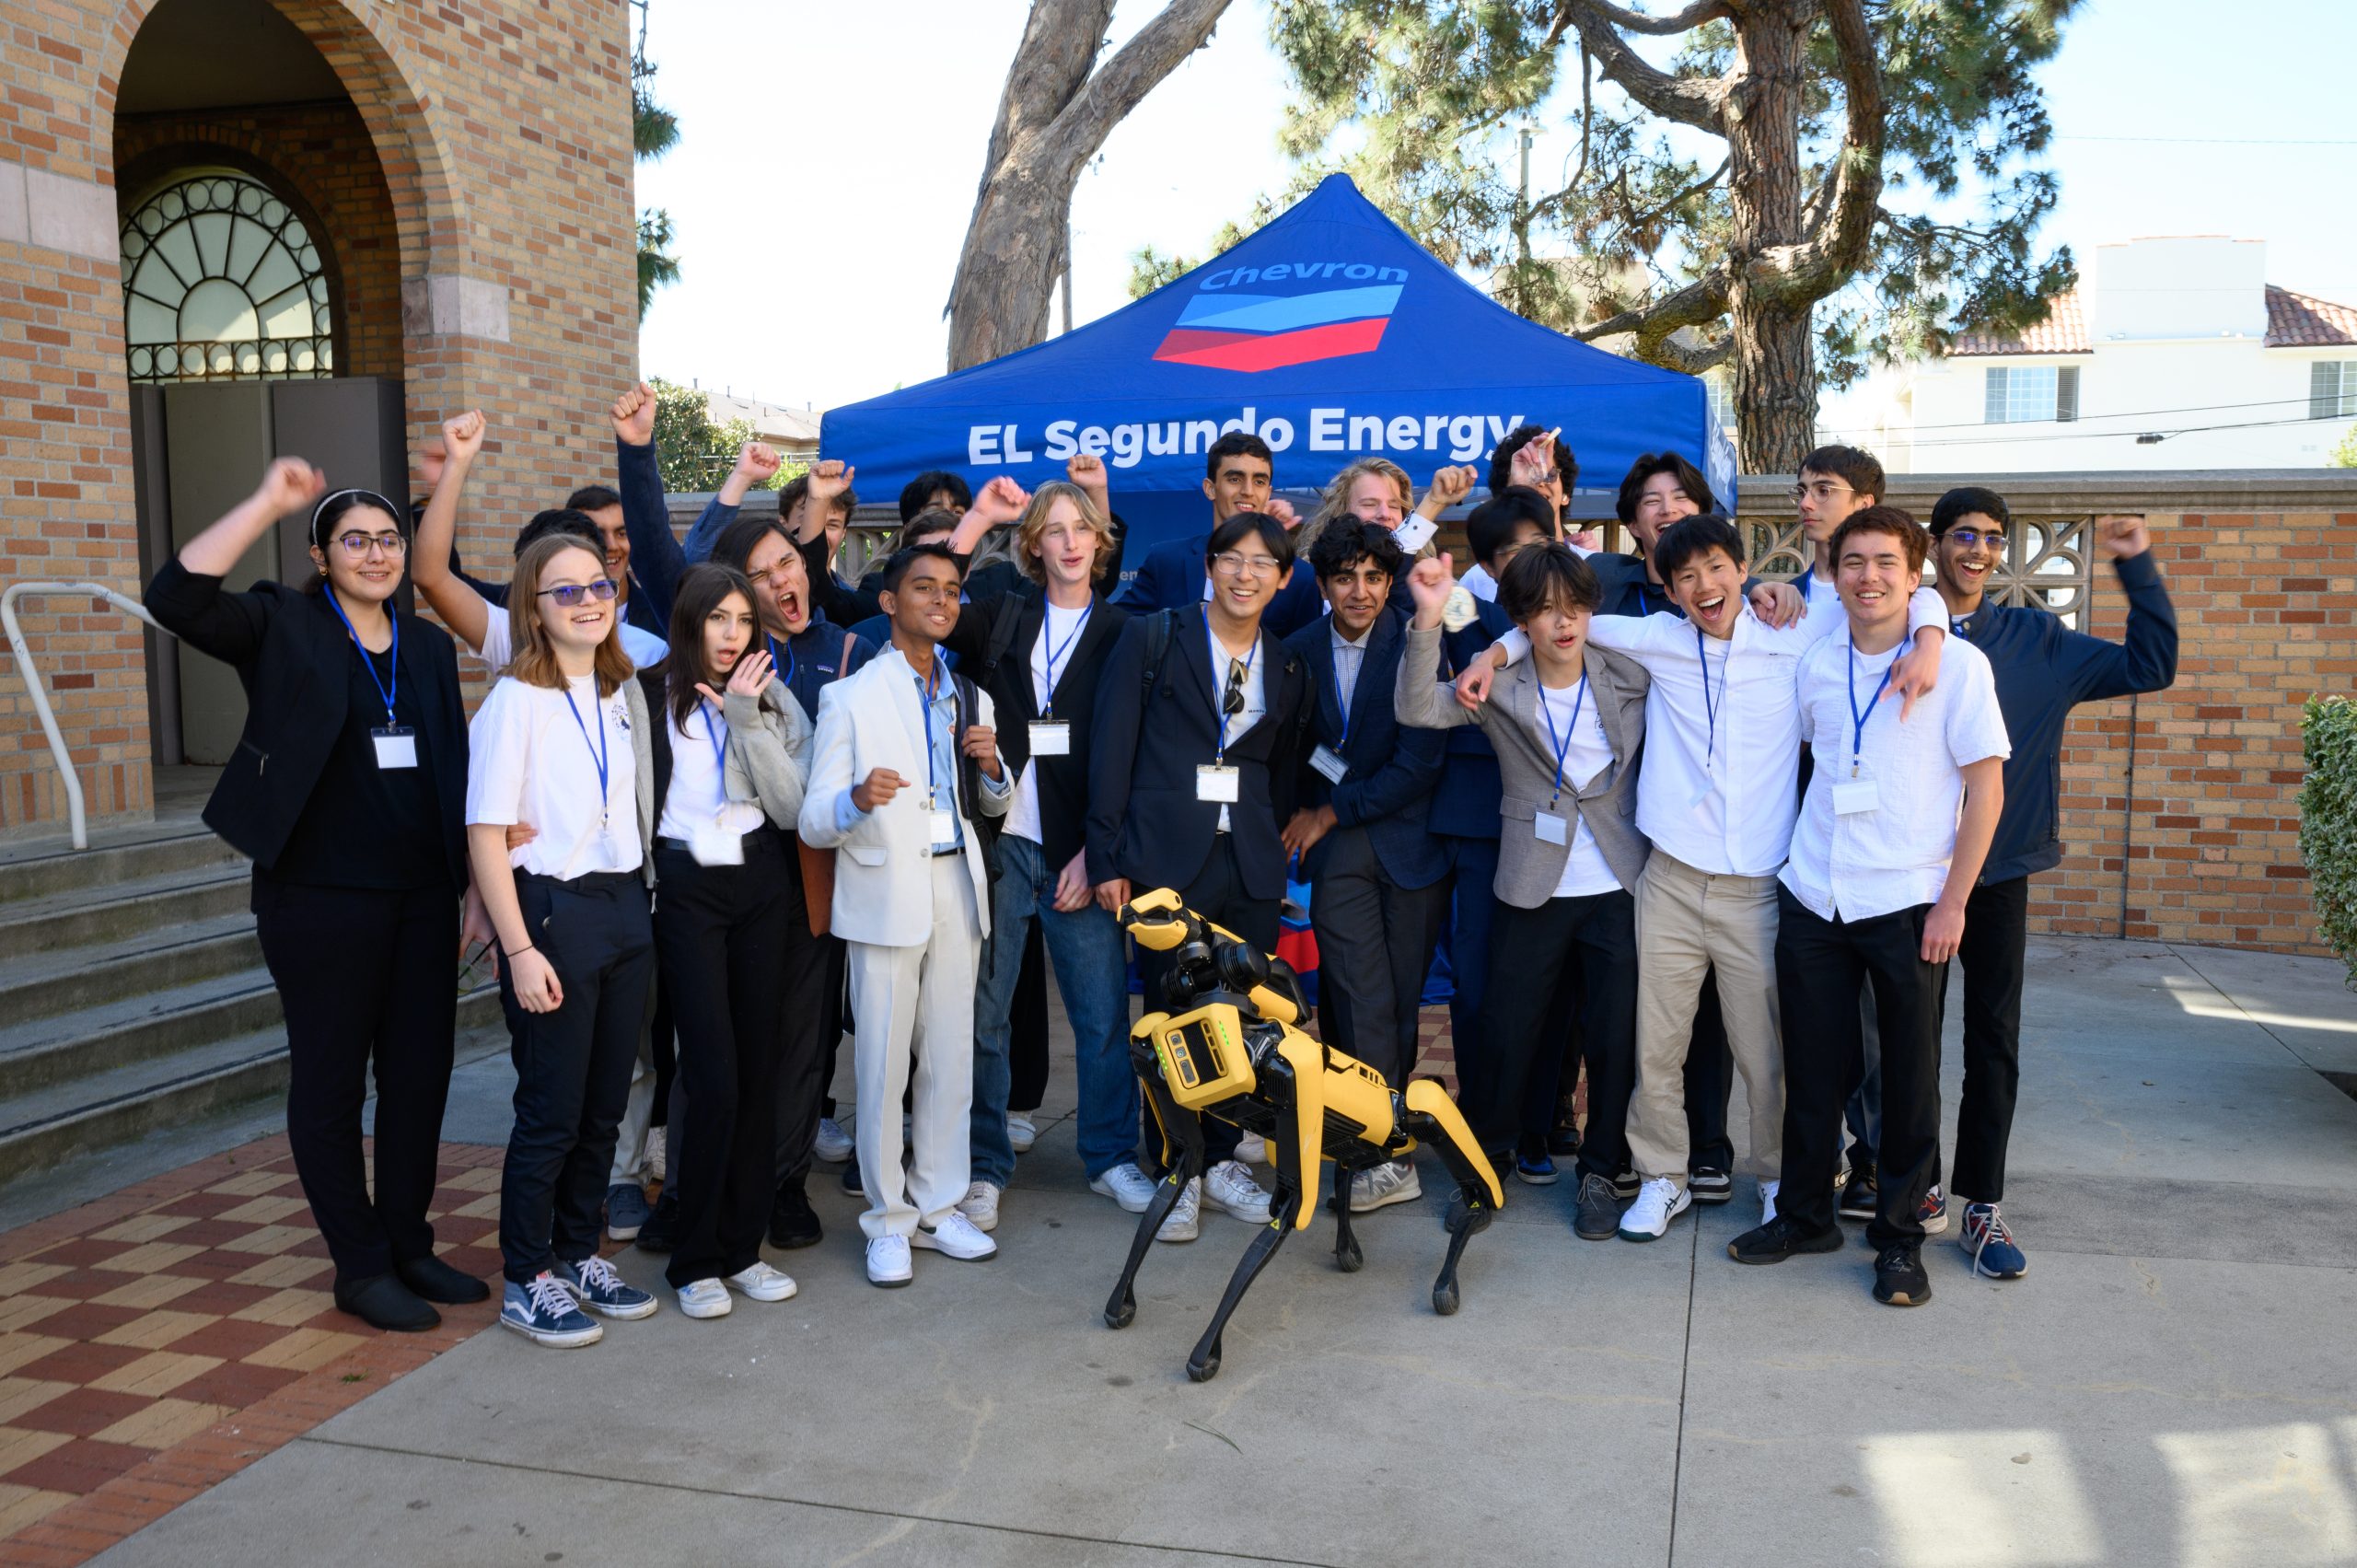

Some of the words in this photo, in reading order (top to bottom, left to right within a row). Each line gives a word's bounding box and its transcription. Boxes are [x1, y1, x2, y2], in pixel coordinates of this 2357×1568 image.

[1200, 261, 1410, 291] Chevron
[968, 424, 1033, 466] EL
[1044, 406, 1295, 468] Segundo
[1309, 408, 1526, 462] Energy
